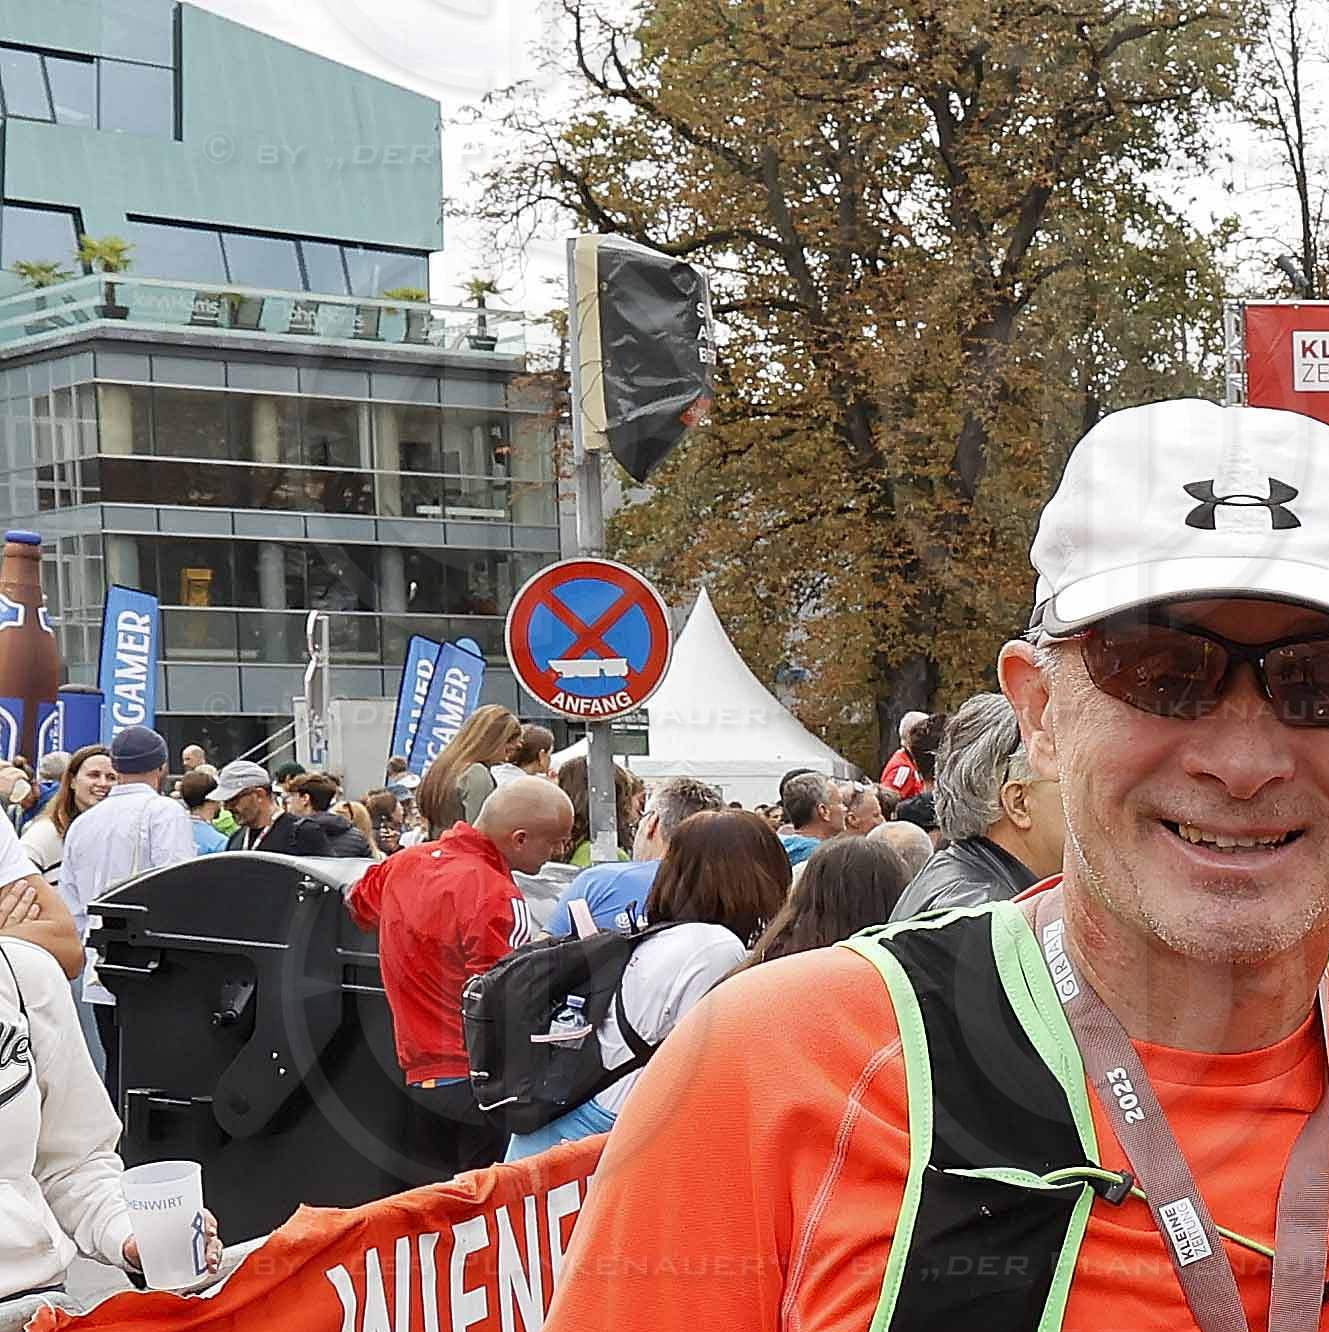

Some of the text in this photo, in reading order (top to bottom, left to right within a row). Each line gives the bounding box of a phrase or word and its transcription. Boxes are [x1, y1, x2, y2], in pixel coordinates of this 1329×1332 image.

[551, 690, 634, 714] ANFANG
[1045, 919, 1078, 998] GRAZ
[1106, 1066, 1146, 1124] 2023
[1165, 1207, 1193, 1262] KLEINE
[1178, 1200, 1209, 1254] ZEITUNG
